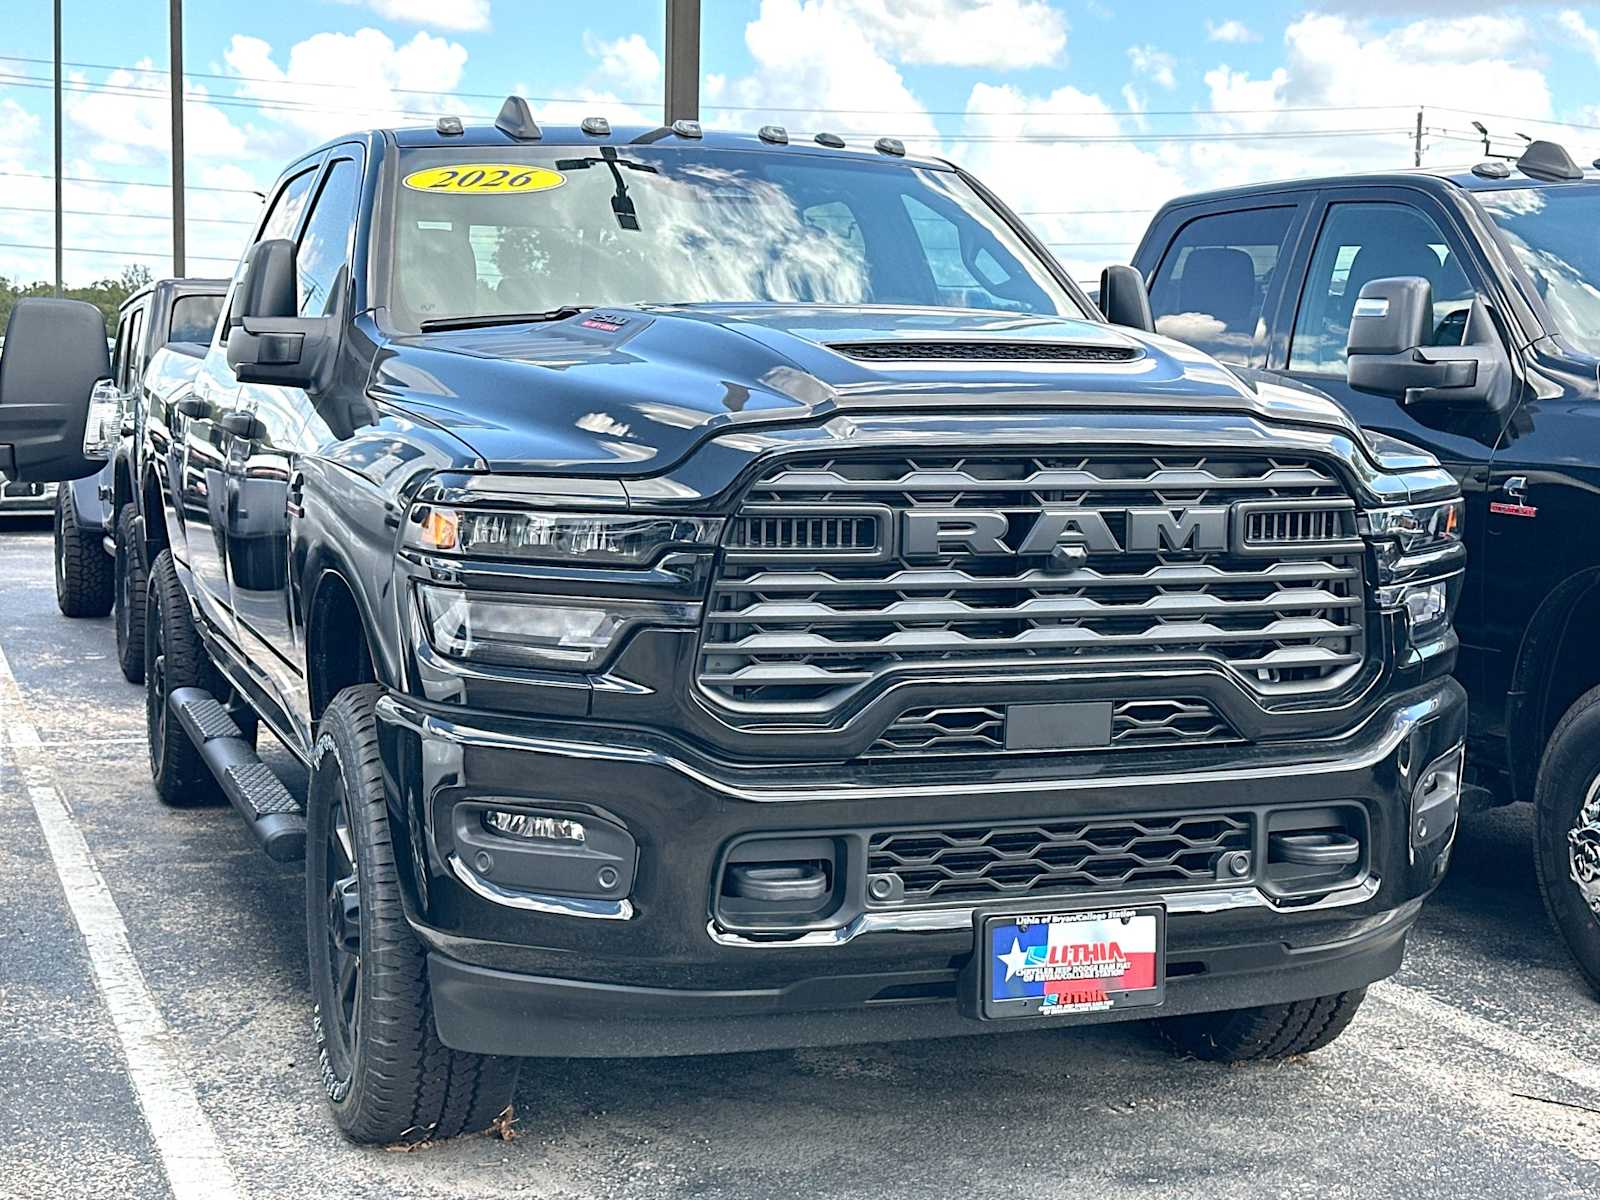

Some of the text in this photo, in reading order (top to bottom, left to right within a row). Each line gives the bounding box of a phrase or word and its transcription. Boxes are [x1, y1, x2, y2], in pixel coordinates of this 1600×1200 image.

[428, 169, 538, 188] 2026
[903, 508, 1229, 556] RAM
[1049, 942, 1125, 964] LITHIA
